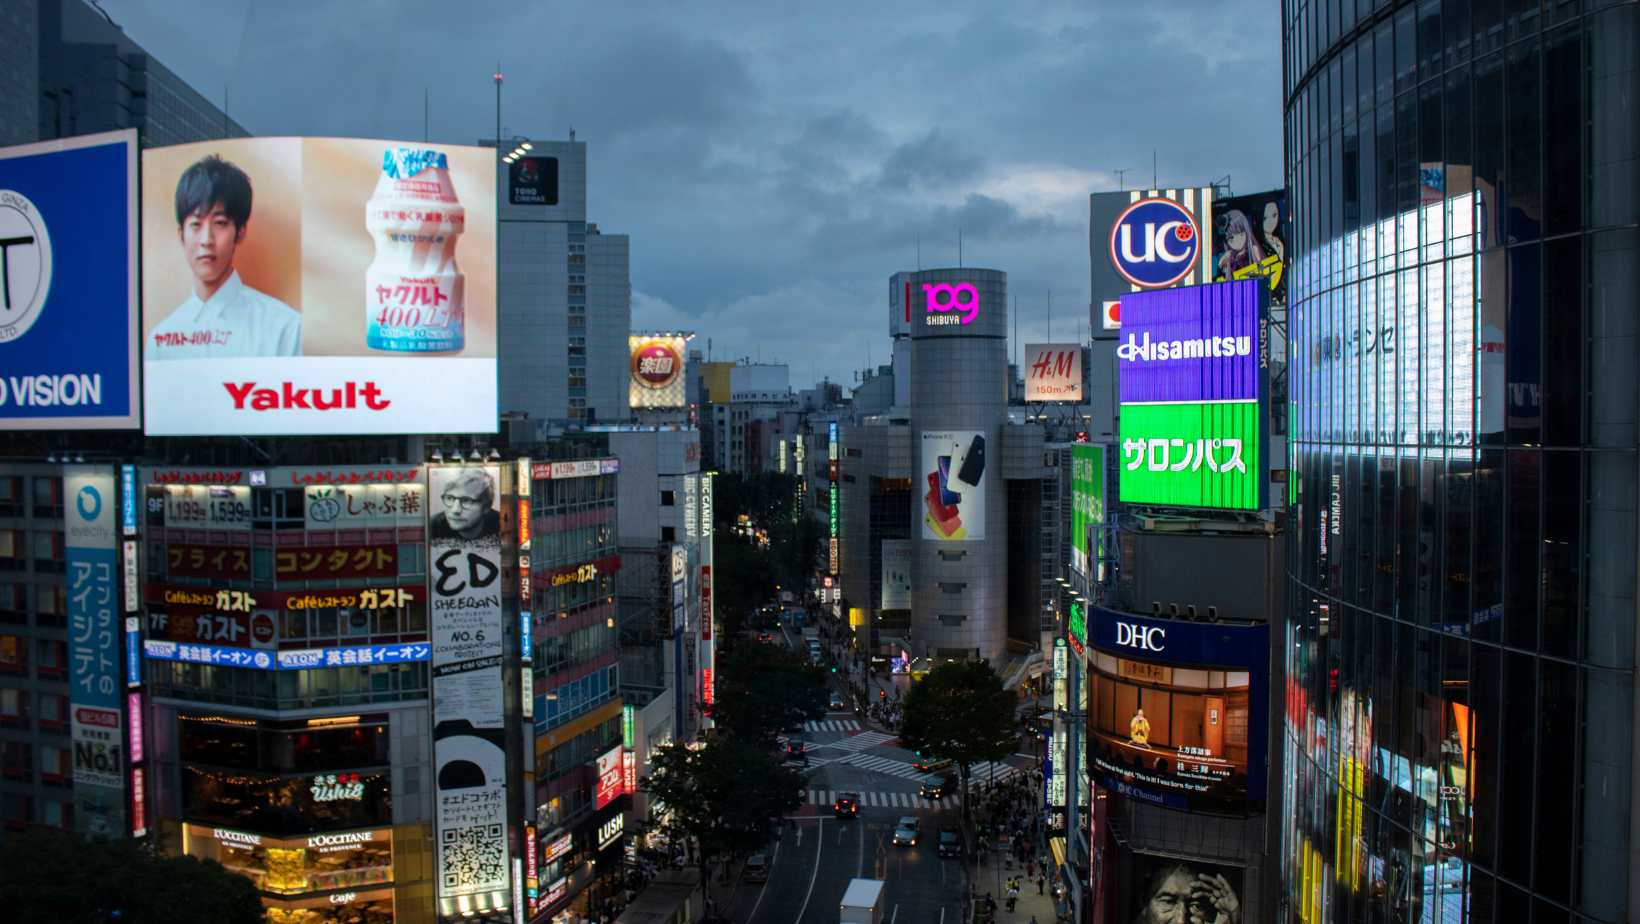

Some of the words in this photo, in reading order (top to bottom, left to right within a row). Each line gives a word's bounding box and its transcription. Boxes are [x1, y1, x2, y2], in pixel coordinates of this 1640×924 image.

[1, 192, 29, 213] GINZA
[514, 195, 546, 203] CINEMAS
[375, 284, 449, 307] ヤクルト
[922, 283, 979, 324] 109
[926, 315, 960, 325] SHIBUYA
[1116, 332, 1251, 362] Hisamitsu
[1259, 318, 1269, 369] サロンパス
[639, 356, 674, 375] 楽園
[1031, 350, 1075, 379] H&M
[10, 373, 102, 408] VISION
[222, 380, 391, 412] Yakult
[1121, 438, 1247, 474] サロンパス
[152, 470, 242, 484] しゃぶしゃぶバイキング
[292, 470, 419, 486] しゃぶしゃぶバイキング
[701, 477, 710, 494] BIC
[148, 498, 164, 513] 9F
[347, 491, 421, 516] しゃぶ葉
[701, 495, 710, 537] CAMERA
[71, 525, 109, 540] eyecity
[169, 548, 250, 572] プライス
[276, 547, 395, 573] コンタクト
[435, 549, 499, 597] ED
[577, 564, 598, 584] ガスト
[215, 590, 258, 613] ガスト
[359, 588, 414, 610] ガスト
[434, 595, 500, 611] SHEERAN
[71, 561, 95, 694] アイシティ
[96, 563, 115, 695] コンタクトの
[149, 613, 169, 630] 7F
[194, 613, 247, 642] ガスト
[435, 641, 502, 653] COLLABORATIONS
[1116, 621, 1166, 652] DHC
[178, 645, 253, 665] 英会話イーオン
[327, 645, 429, 667] 英会話イーオン
[440, 663, 462, 674] NOW
[462, 661, 476, 670] ON
[73, 739, 122, 777] No.1
[601, 769, 619, 791] アコム
[1170, 780, 1184, 789] born
[1184, 782, 1195, 790] for
[442, 789, 503, 806] #エドコラボ
[1118, 782, 1133, 795] DHC
[1133, 788, 1164, 803] Channel
[214, 828, 261, 845] L'OCCITANE
[308, 831, 373, 848] L'OCCITANE
[598, 812, 624, 845] LUSH
[329, 891, 357, 905] Café
